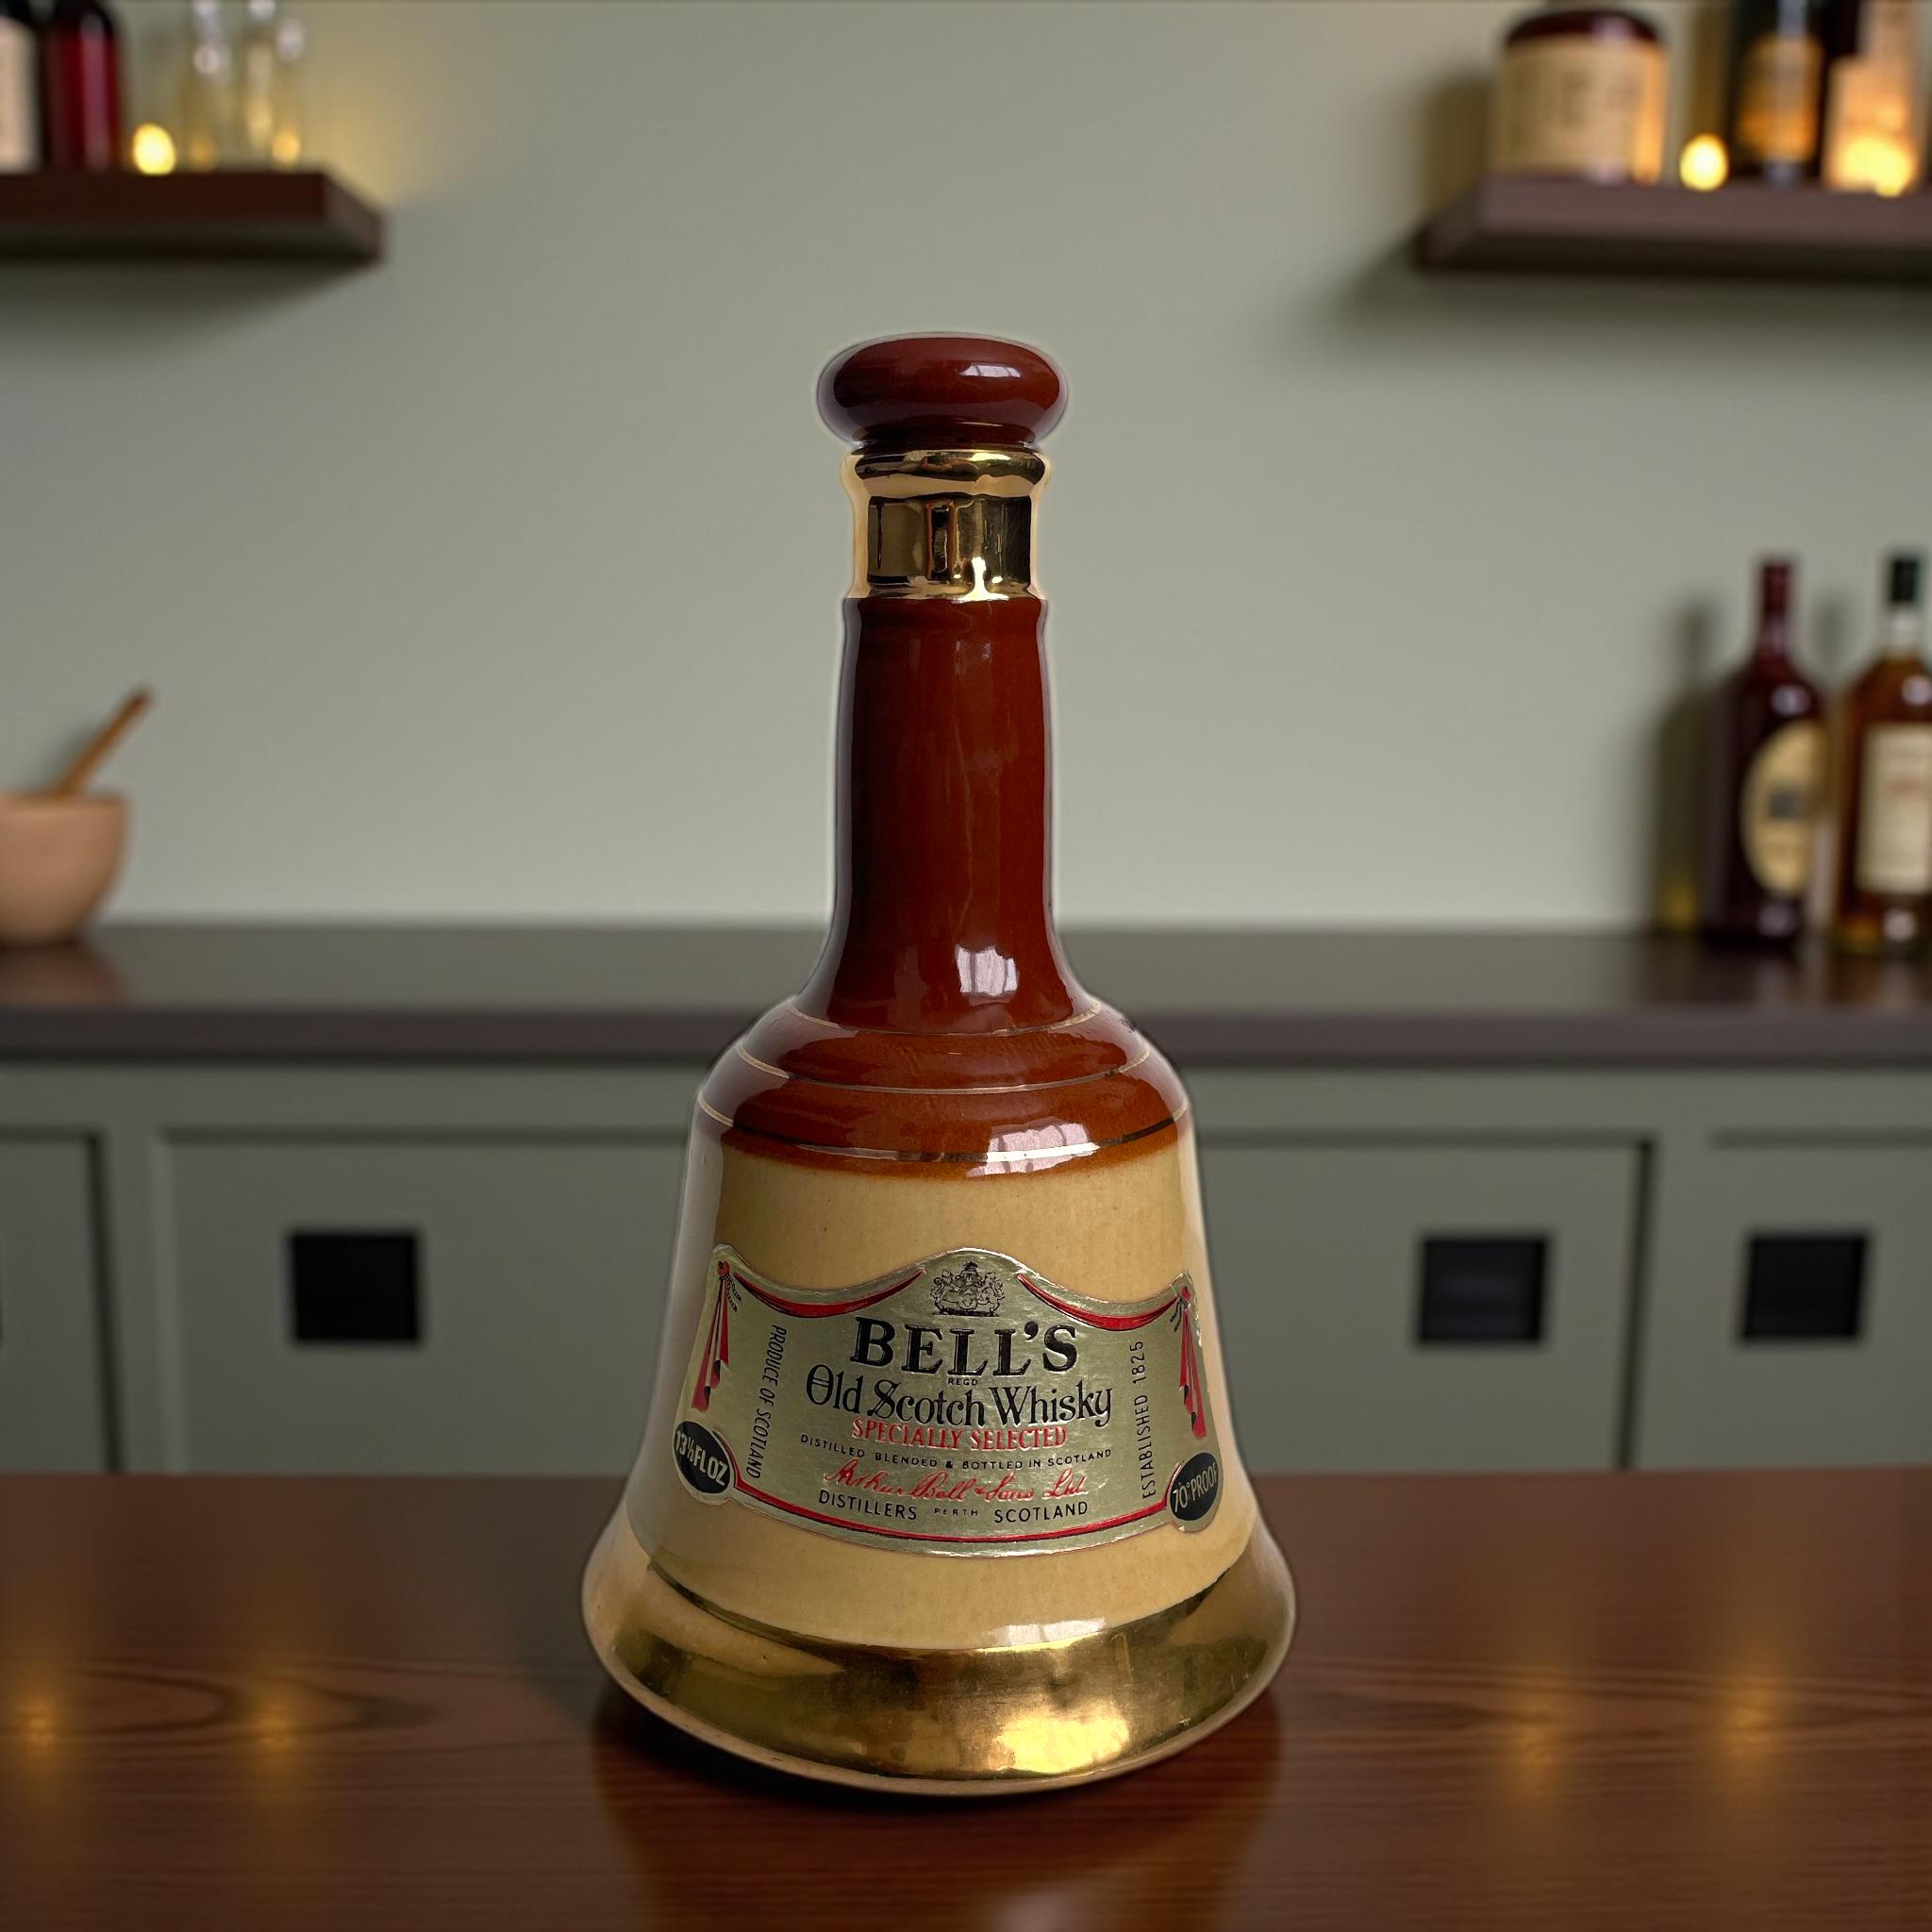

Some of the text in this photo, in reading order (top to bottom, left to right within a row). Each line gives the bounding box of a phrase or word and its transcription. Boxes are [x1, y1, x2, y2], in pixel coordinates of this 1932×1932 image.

[850, 1315, 1079, 1376] BELL'S
[745, 1324, 788, 1479] PRODUCE OF SCOTLAND
[806, 1363, 1114, 1428] Old Scotch Whisky
[1129, 1341, 1157, 1500] ESTABLISHED 1825
[800, 1433, 866, 1458] DISTILLED
[874, 1452, 938, 1468] BLENDED
[962, 1459, 1024, 1471] BOTTLED
[1028, 1458, 1041, 1469] IN
[1047, 1448, 1112, 1468] SCOTLAND
[851, 1416, 1068, 1452] SPECIALLY SELECTED
[818, 1489, 1089, 1524] DISTILLERS PERTH SCOTLAND
